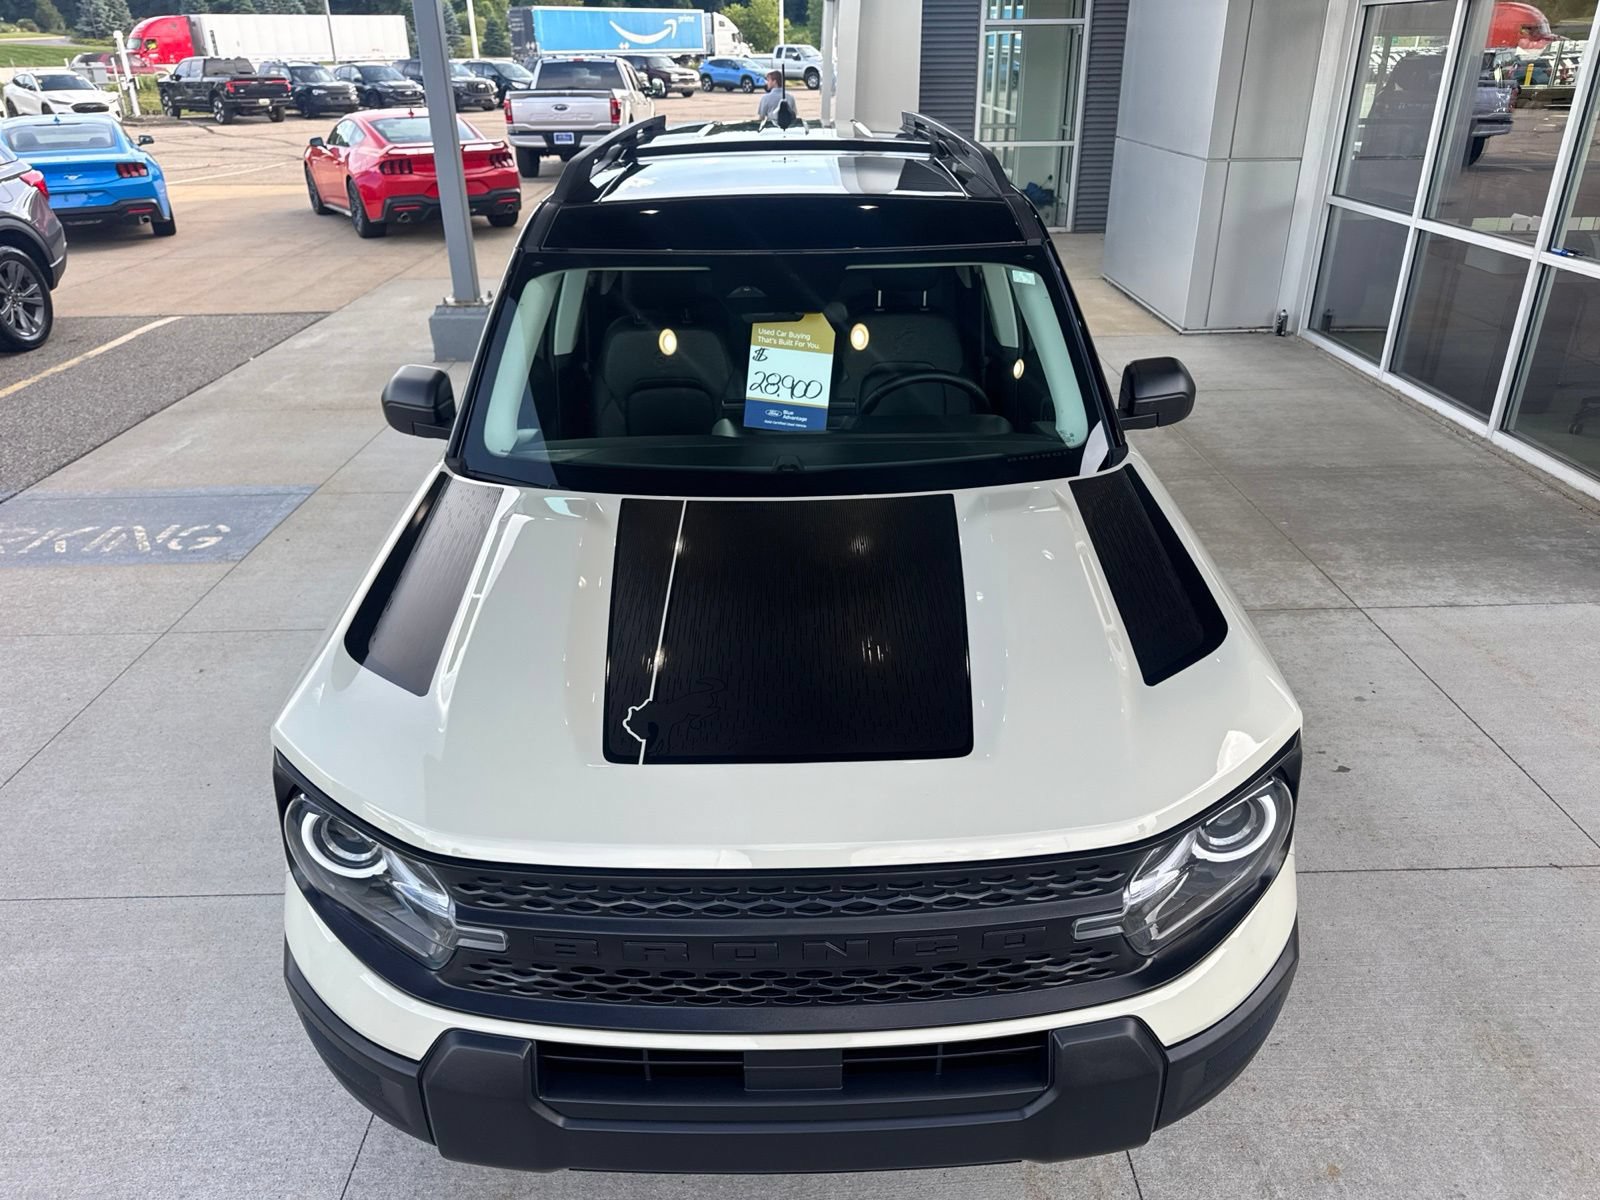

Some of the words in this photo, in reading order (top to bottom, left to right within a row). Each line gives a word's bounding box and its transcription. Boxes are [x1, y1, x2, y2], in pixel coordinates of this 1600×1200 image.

[757, 336, 777, 345] That's
[778, 339, 793, 347] Built
[758, 328, 775, 336] Used
[788, 332, 811, 341] Buying
[752, 347, 769, 362] $
[533, 926, 1047, 962] BRONCO
